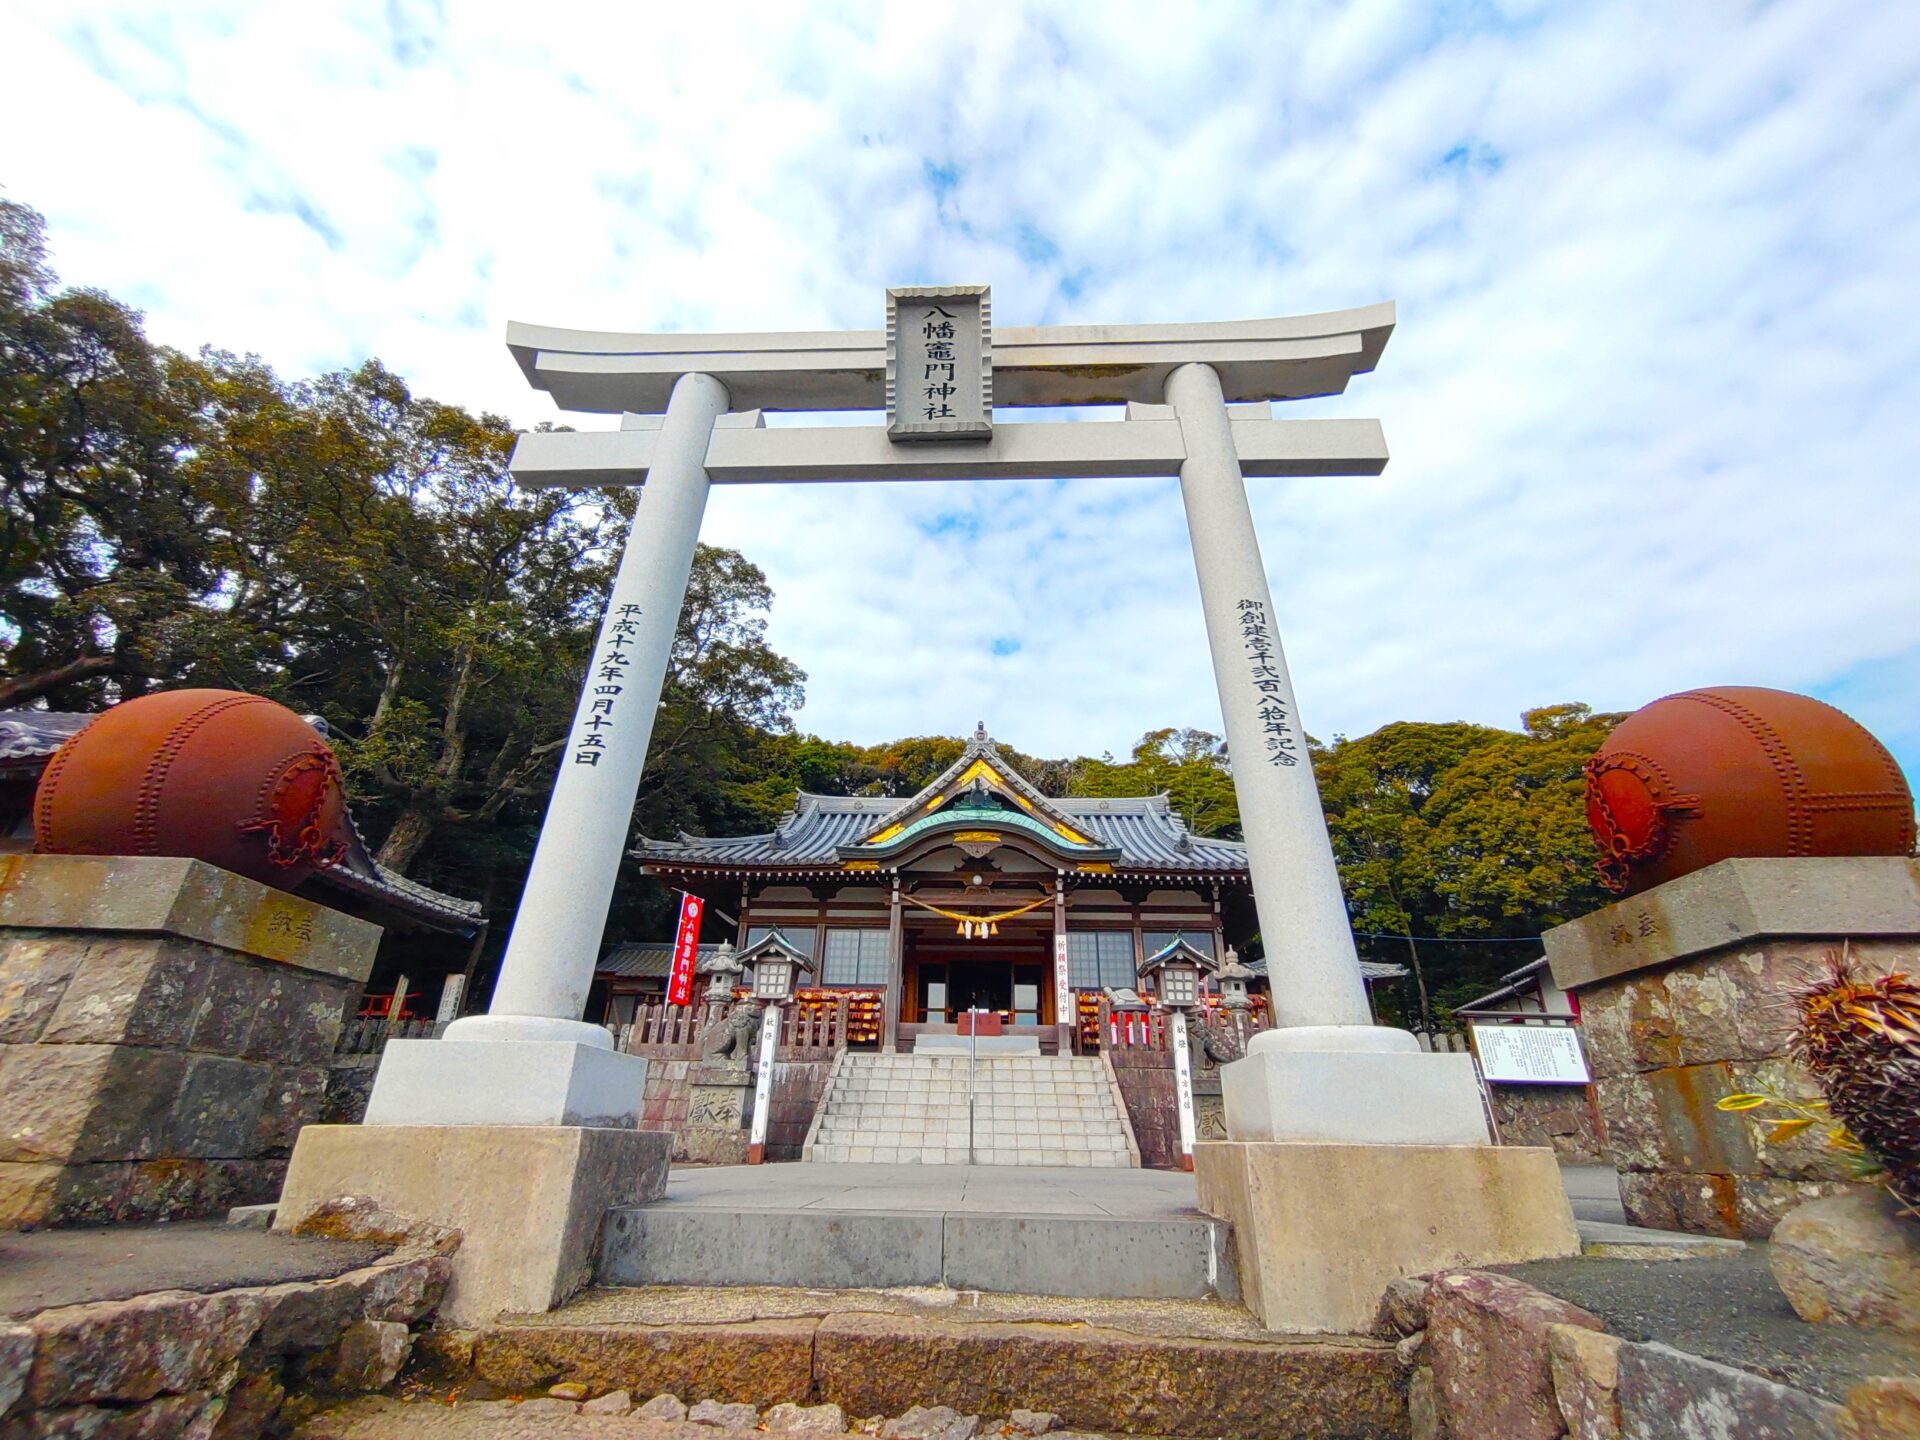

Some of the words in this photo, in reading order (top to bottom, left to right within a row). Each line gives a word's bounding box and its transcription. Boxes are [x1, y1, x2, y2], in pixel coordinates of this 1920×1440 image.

[921, 305, 958, 421] 八幡竈門神社
[575, 603, 643, 767] 平成十九年四月十五日
[1057, 940, 1068, 1016] 祈願祭受付中
